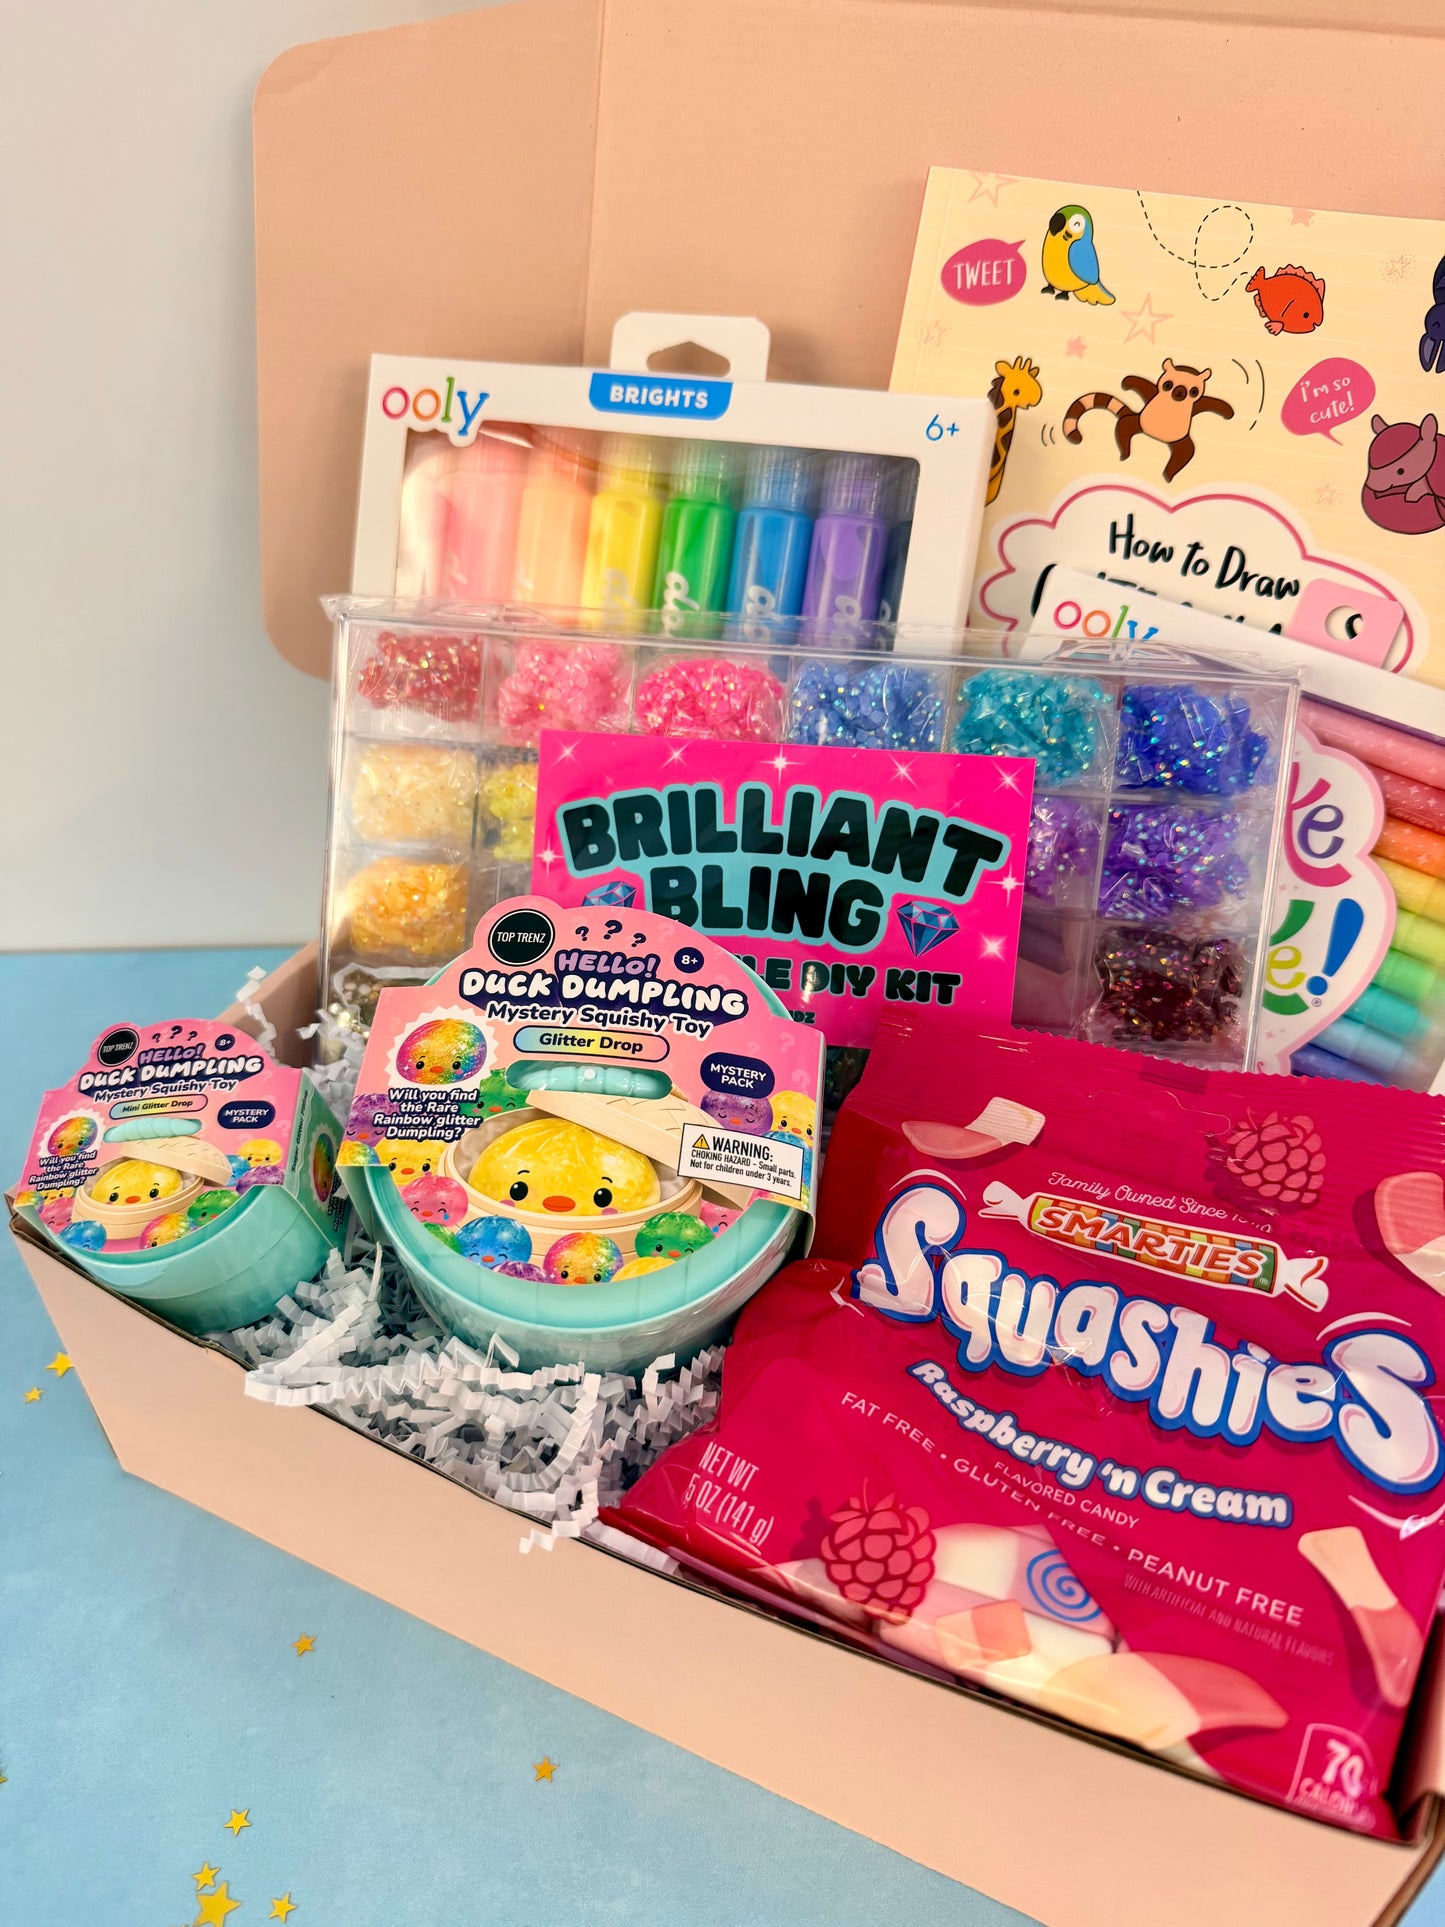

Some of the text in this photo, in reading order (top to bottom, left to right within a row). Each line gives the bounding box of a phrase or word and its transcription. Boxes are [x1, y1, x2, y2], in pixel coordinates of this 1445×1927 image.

[953, 259, 1015, 290] TWEET
[1332, 377, 1351, 391] so
[381, 376, 491, 437] ooly
[609, 384, 710, 410] BRIGHTS
[1309, 390, 1355, 424] cute!
[925, 413, 960, 442] 6+
[1108, 513, 1300, 600] How to Draw
[560, 785, 1006, 899] BRILLIANT
[649, 863, 886, 948] BLING
[496, 930, 547, 944] TOP TRENZ
[556, 951, 659, 978] HELLO!
[681, 954, 699, 966] 8+
[801, 960, 877, 997] DIY
[884, 967, 963, 1006] KIT
[487, 1003, 711, 1039] Mystery Squishy Toy
[102, 1043, 115, 1054] TOP
[140, 1044, 205, 1064] HELLO!
[218, 1038, 232, 1047] 8+
[539, 1032, 644, 1054] Glitter Drop
[710, 1062, 767, 1082] MYSTERY
[721, 1075, 755, 1089] PACK
[94, 1078, 238, 1103] Mystery Squishy Toy
[389, 1088, 478, 1103] Will you find
[122, 1099, 194, 1113] Mini Glitter Drop
[225, 1108, 269, 1117] MYSTERY
[400, 1101, 459, 1113] the Rare
[232, 1115, 259, 1124] PACK
[373, 1113, 481, 1127] Rainbow glitter
[386, 1126, 461, 1140] Dumpling?
[40, 1156, 59, 1166] Will
[79, 1151, 97, 1160] find
[712, 1135, 774, 1162] WARNING:
[29, 1168, 98, 1183] Rainbow glitter
[46, 1162, 85, 1173] the Rare
[690, 1159, 702, 1169] Not
[703, 1160, 714, 1170] for
[715, 1162, 744, 1175] children
[745, 1169, 765, 1180] under
[772, 1175, 792, 1187] years.
[691, 1149, 723, 1162] CHOKING
[724, 1153, 752, 1167] HAZARD
[758, 1161, 778, 1173] Small
[778, 1166, 797, 1179] parts.
[37, 1177, 86, 1190] Dumpling?
[1048, 1171, 1228, 1219] Family Owned Since
[1036, 1206, 1267, 1278] SMARTIES
[909, 1361, 1097, 1488] Raspberry
[1143, 1469, 1289, 1525] Cream
[698, 1441, 761, 1493] NET WT
[994, 1461, 1141, 1530] FLAVORED CANDY
[685, 1473, 776, 1547] 5 OZ (141 g)
[841, 1391, 1305, 1628] FAT FREE GLUTEN FREE PEANUT FREE
